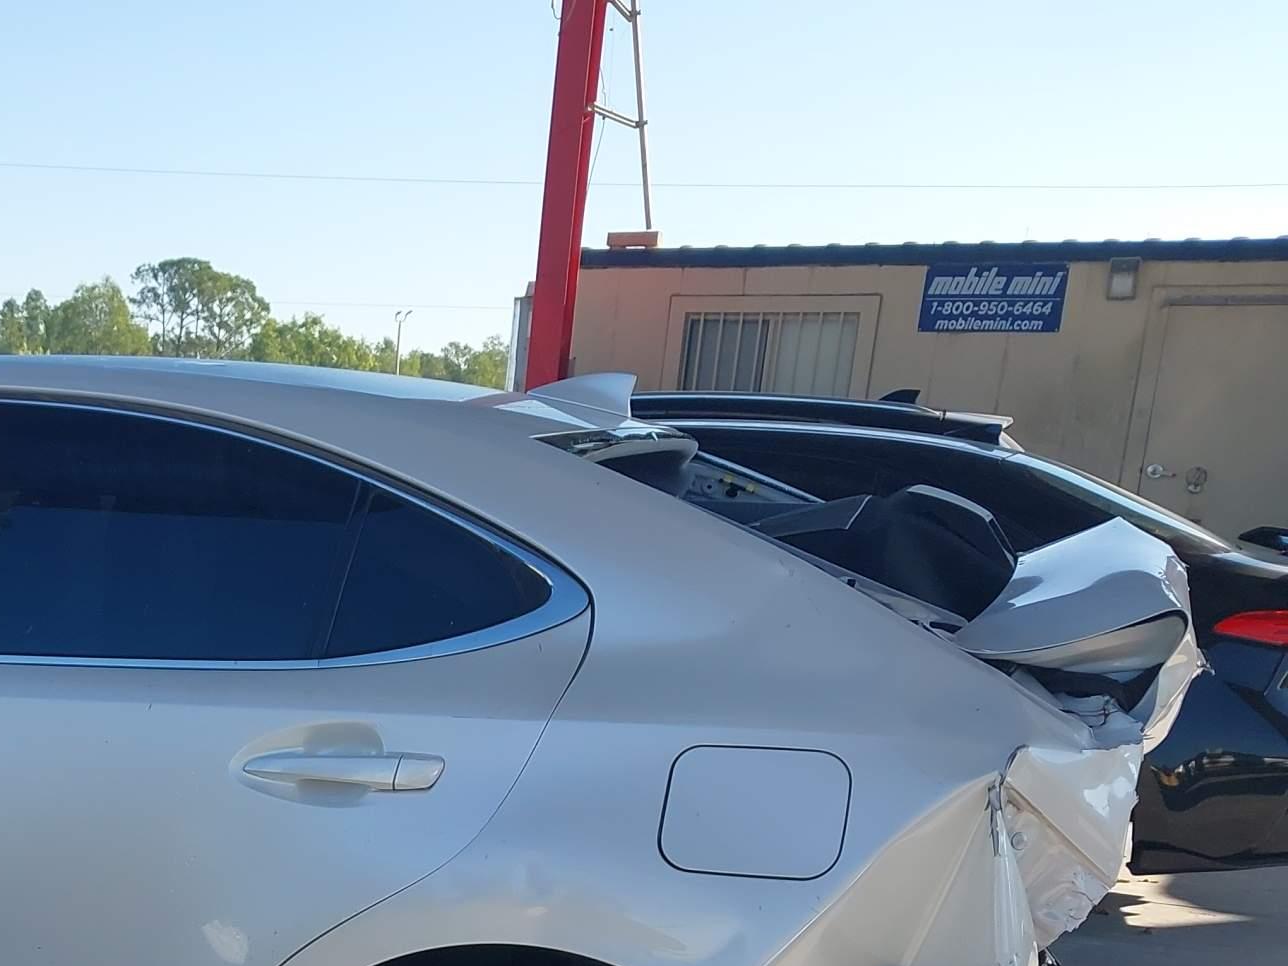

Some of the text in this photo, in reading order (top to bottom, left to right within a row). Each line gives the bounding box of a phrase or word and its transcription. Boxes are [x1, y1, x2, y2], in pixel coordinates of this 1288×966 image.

[927, 267, 1064, 295] mobile mini
[930, 301, 1053, 315] 1-800-950-6464
[935, 317, 1043, 331] mobilemini.com
